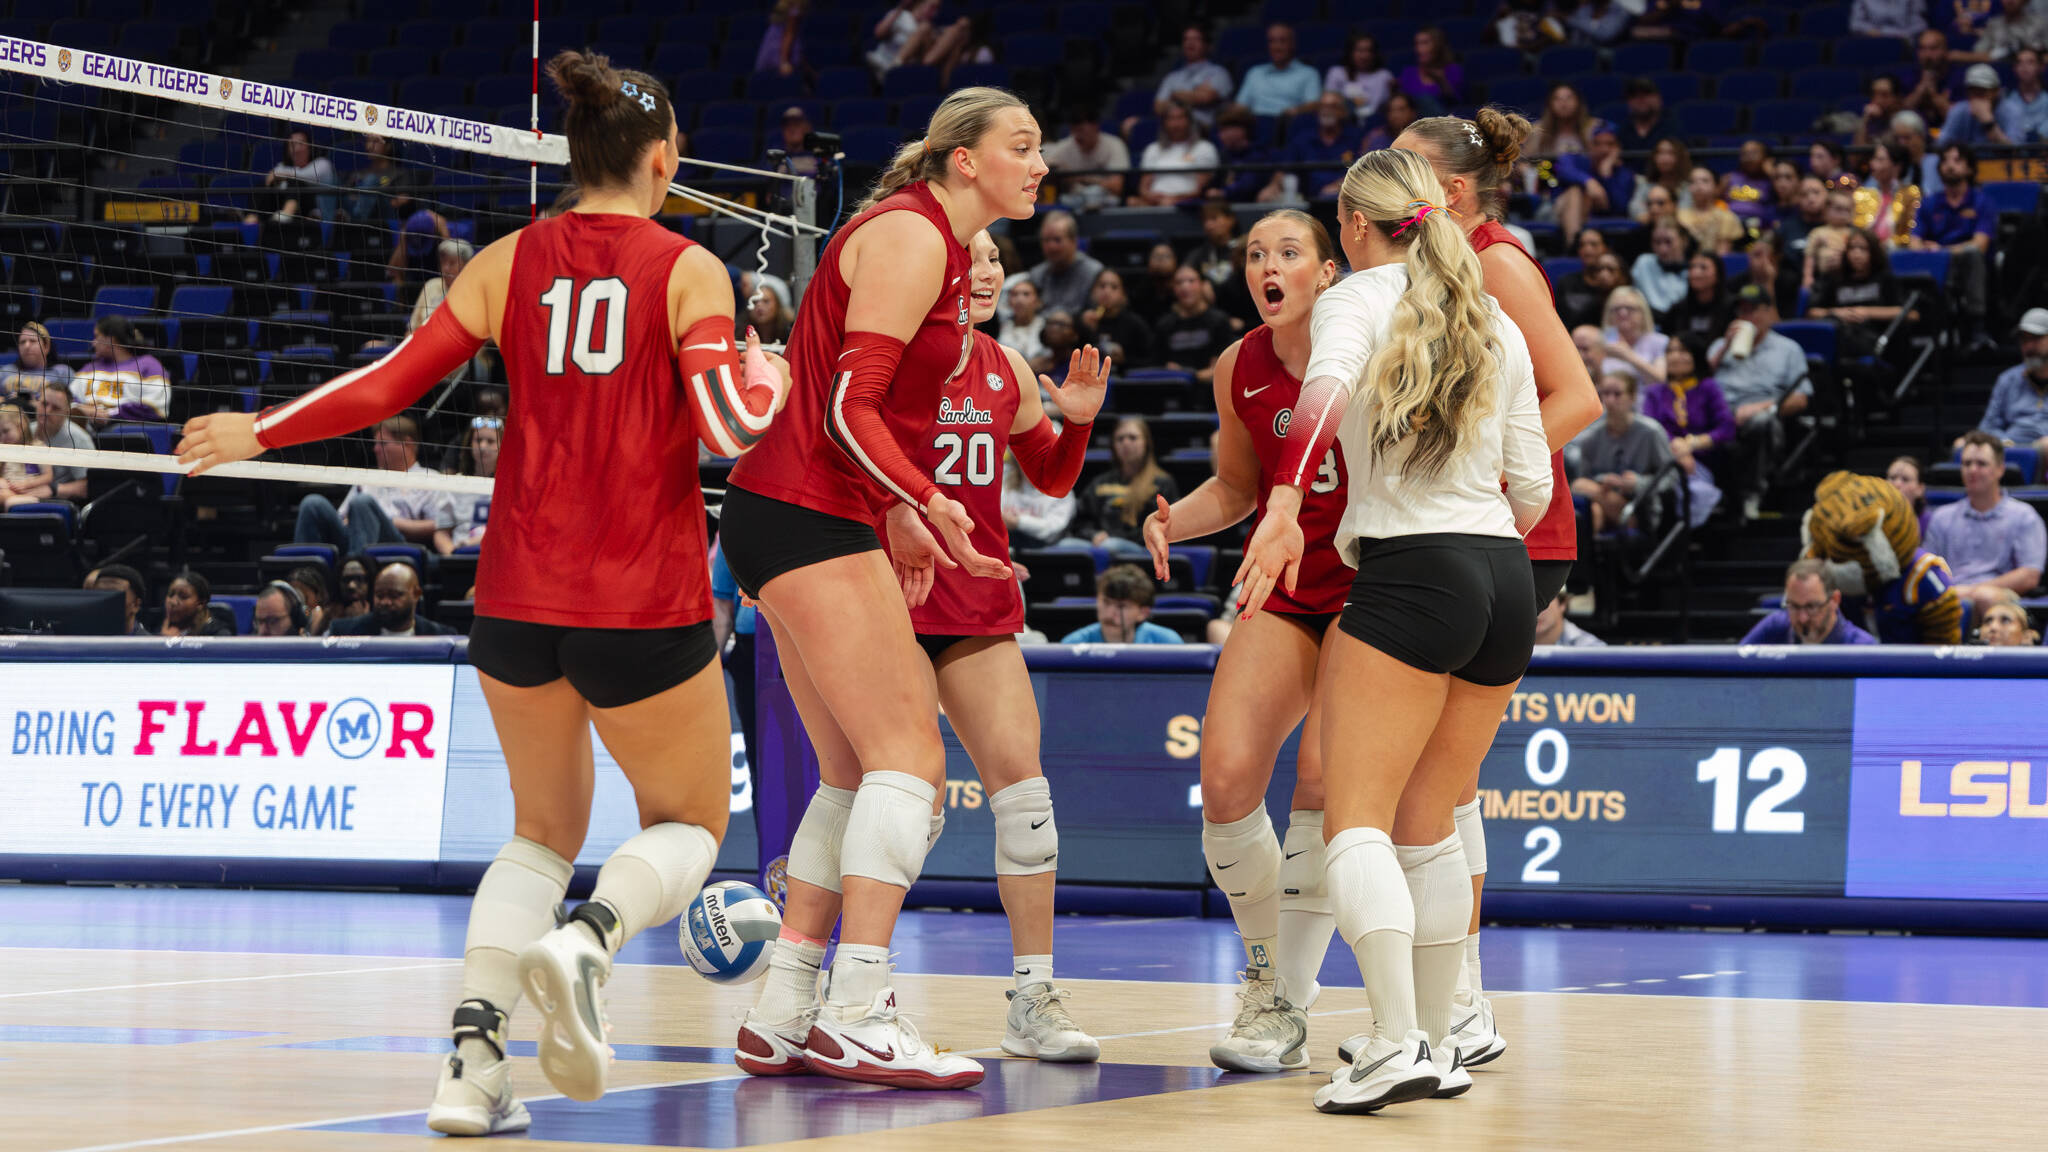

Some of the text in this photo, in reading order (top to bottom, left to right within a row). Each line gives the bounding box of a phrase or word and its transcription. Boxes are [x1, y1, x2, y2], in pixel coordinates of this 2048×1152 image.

[82, 53, 209, 96] GEAUX TIGERS
[241, 82, 358, 122] GEAUX TIGERS
[386, 109, 493, 145] GEAUX TIGERS
[539, 275, 630, 376] 10
[936, 396, 994, 425] Carolina
[932, 431, 996, 487] 20
[12, 697, 435, 759] BRING FLAVOR
[1502, 692, 1636, 723] TS WON
[1524, 727, 1570, 786] 0
[81, 782, 357, 831] TO EVERY GAME
[1696, 746, 1808, 834] 12
[1900, 760, 2048, 818] LSU
[1520, 825, 1562, 883] 2
[705, 894, 736, 948] molten
